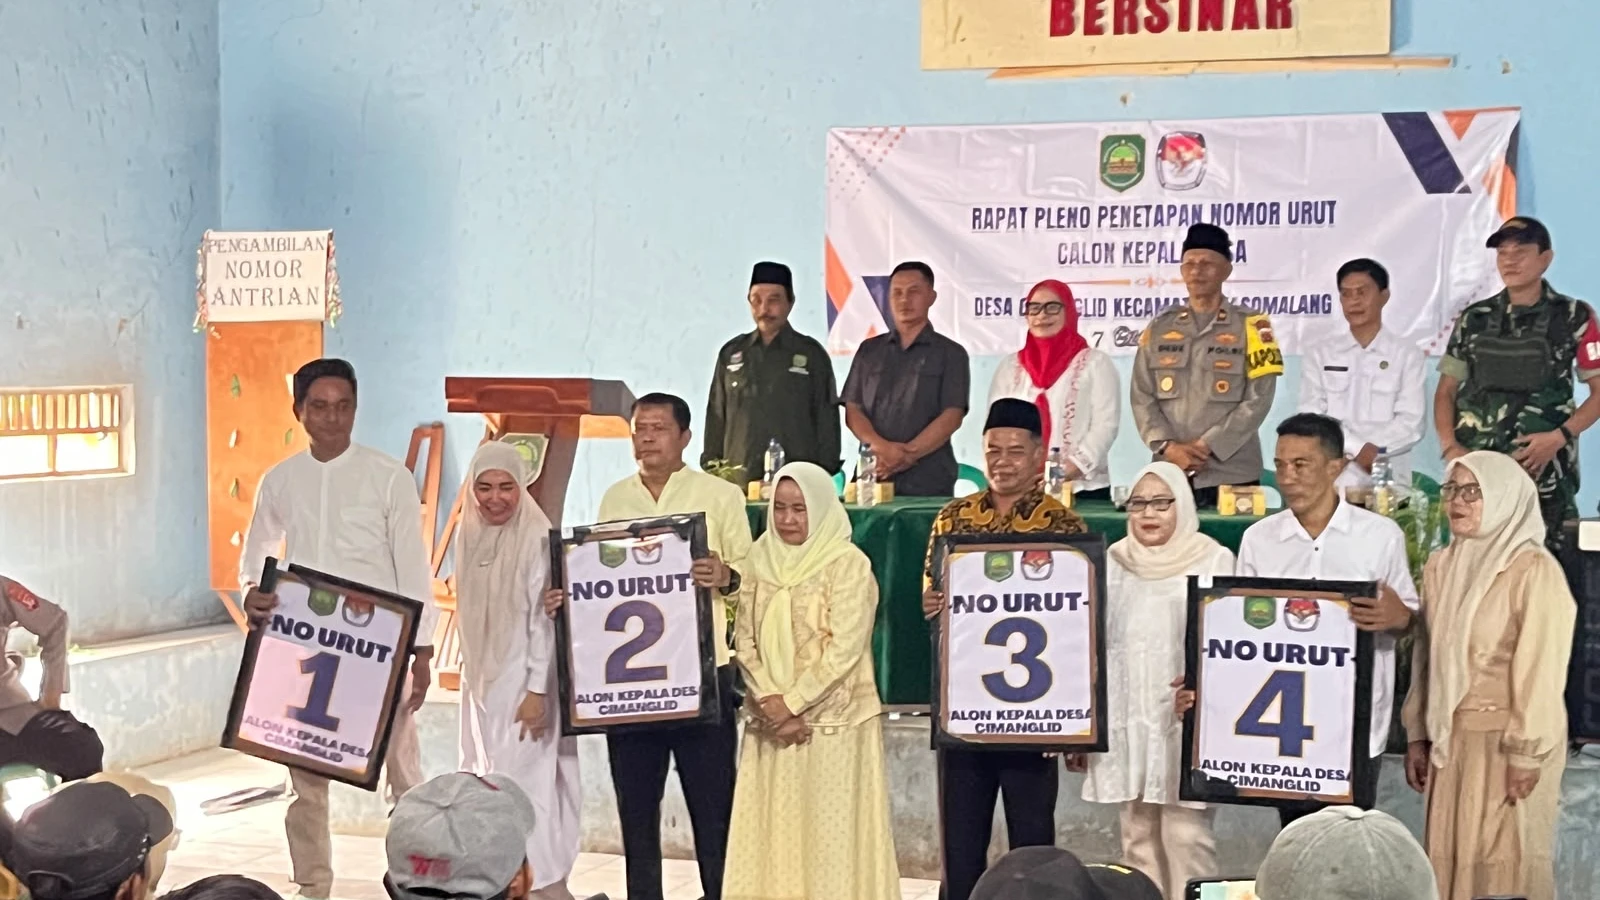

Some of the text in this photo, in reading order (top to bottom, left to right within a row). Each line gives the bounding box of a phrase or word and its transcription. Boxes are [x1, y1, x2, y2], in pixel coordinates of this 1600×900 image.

[1050, 0, 1293, 37] BERSINAR
[972, 200, 1337, 230] RAPAT PLENO PENETAPAN NOMOR URUT
[207, 237, 325, 253] PENGAMBILAN
[1057, 241, 1184, 265] CALON KEPAL
[225, 259, 302, 279] NOMOR
[211, 286, 320, 307] ANTRIAN
[974, 297, 1013, 316] DESA
[572, 573, 692, 601] NO URUT
[952, 592, 1082, 614] NO URUT
[271, 614, 392, 663] NO URUT
[604, 600, 668, 684] 2
[981, 616, 1053, 703] 3
[1207, 638, 1350, 667] NO URUT
[285, 651, 341, 732] 1
[576, 686, 698, 704] ALON KEPALA DES
[599, 700, 678, 715] CIMANGLID
[950, 710, 992, 721] ALON
[996, 709, 1053, 720] KEPALA
[1234, 670, 1315, 758] 4
[245, 715, 369, 758] ALON KEPALA DES
[974, 722, 1063, 733] CIMANGLID
[264, 732, 344, 762] CIMANGLID
[1201, 759, 1246, 774] ALON
[1250, 763, 1313, 778] KEPALA
[1228, 774, 1321, 792] CIMANGLID
